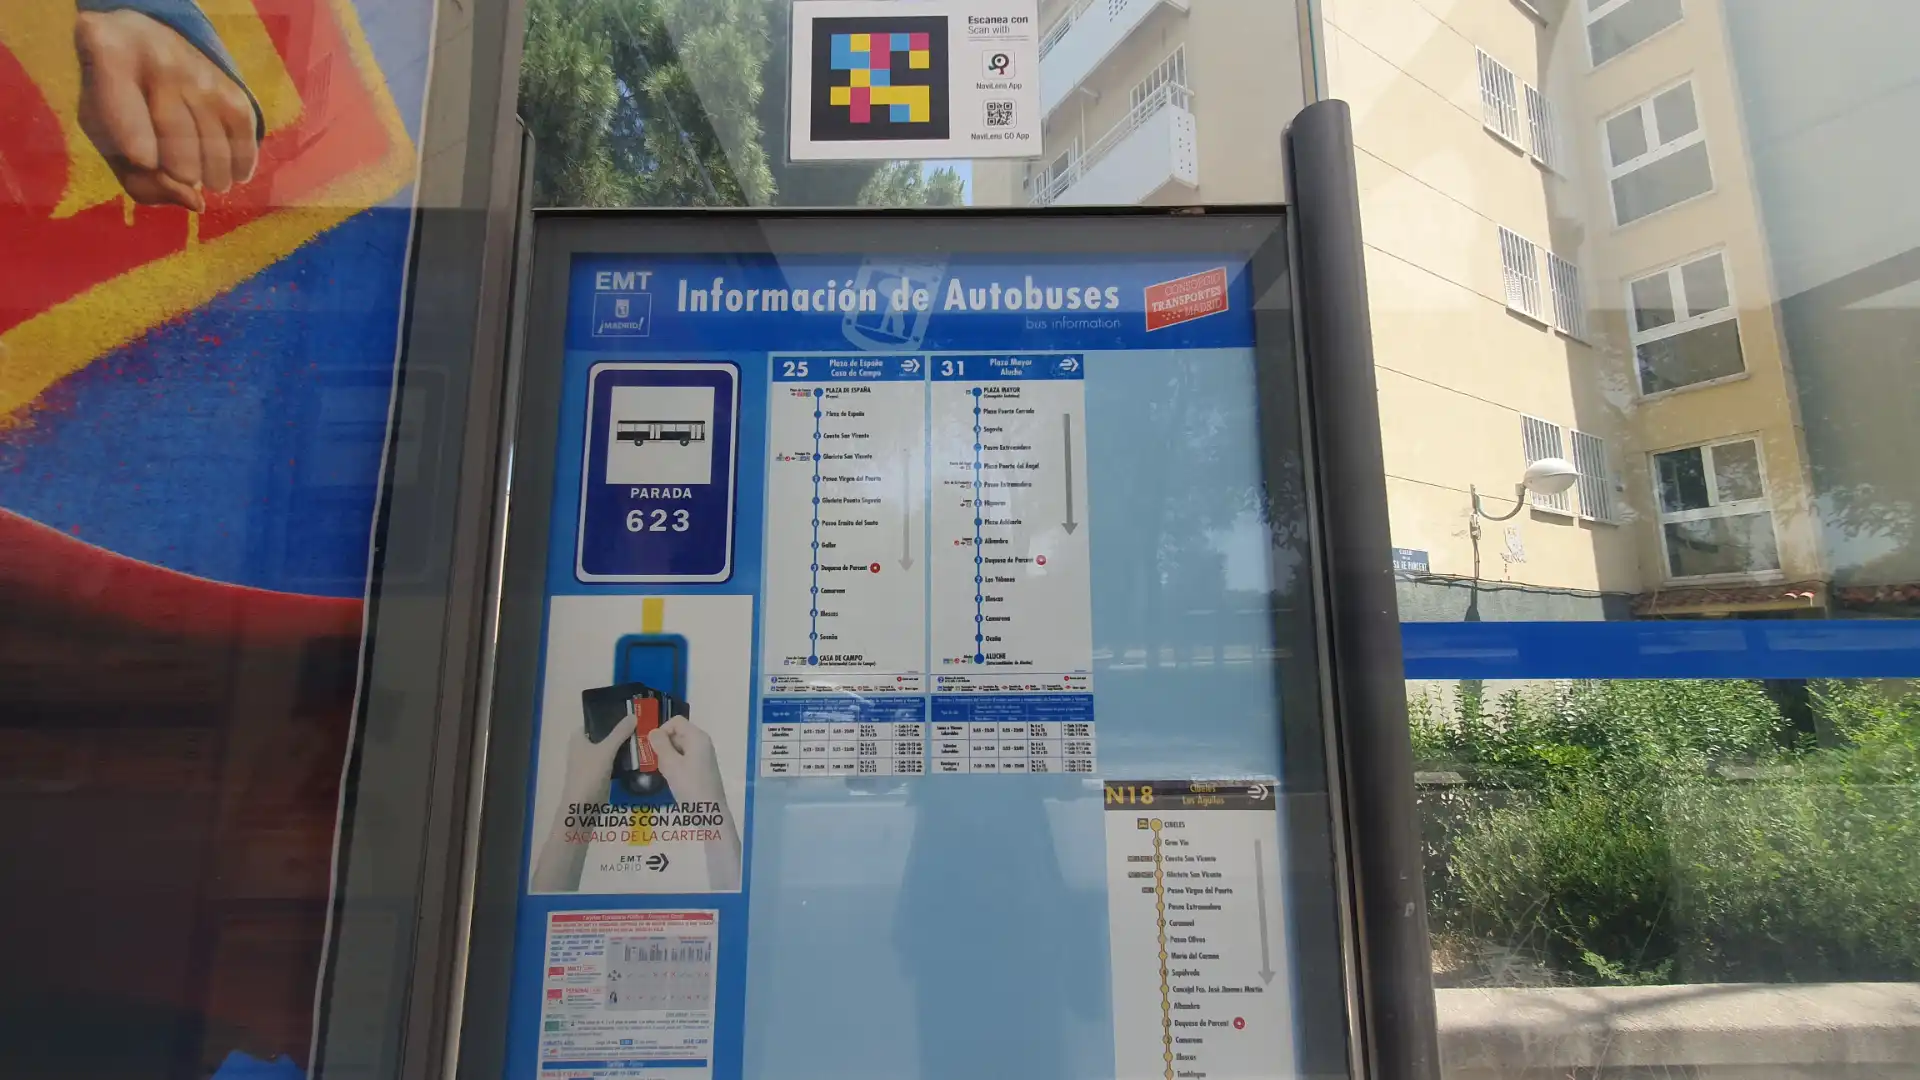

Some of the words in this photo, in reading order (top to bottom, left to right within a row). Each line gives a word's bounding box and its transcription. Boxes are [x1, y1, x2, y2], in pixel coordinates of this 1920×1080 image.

[968, 16, 1008, 24] Escanea
[1011, 16, 1028, 24] con
[968, 26, 990, 34] Scan
[992, 25, 1010, 34] with
[1009, 82, 1022, 90] App
[1016, 132, 1030, 141] App
[595, 271, 652, 290] EMT
[678, 276, 876, 312] Información
[892, 276, 929, 312] de
[944, 276, 1120, 311] Autobuses
[1152, 285, 1221, 312] TRANSPORTES
[1184, 298, 1222, 317] MADRID
[598, 317, 644, 334] ¡MADRID!
[1026, 316, 1047, 330] bus
[1052, 316, 1121, 330] information
[783, 361, 809, 377] 25
[829, 359, 848, 367] Plaza
[850, 359, 857, 367] de
[859, 359, 883, 368] España
[941, 360, 964, 376] 31
[990, 358, 1009, 366] Plaza
[1011, 358, 1032, 368] Mayor
[831, 369, 847, 377] Casa
[848, 369, 857, 377] de
[859, 369, 881, 378] Campo
[1000, 368, 1023, 376] Aluche
[630, 488, 692, 499] PARADA
[626, 509, 690, 532] 623
[1106, 786, 1154, 805] N18
[568, 803, 581, 814] SI
[584, 803, 628, 814] PAGAS
[630, 802, 662, 814] CON
[665, 802, 721, 814] TARJETA
[564, 816, 575, 827] O
[579, 815, 636, 827] VALIDAS
[639, 815, 669, 827] CON
[672, 814, 724, 826] ABONO
[621, 831, 639, 842] DE
[642, 830, 659, 842] LA
[661, 829, 722, 841] CARTERA
[600, 864, 642, 872] MADRID
[1175, 1020, 1198, 1028] Duquesa
